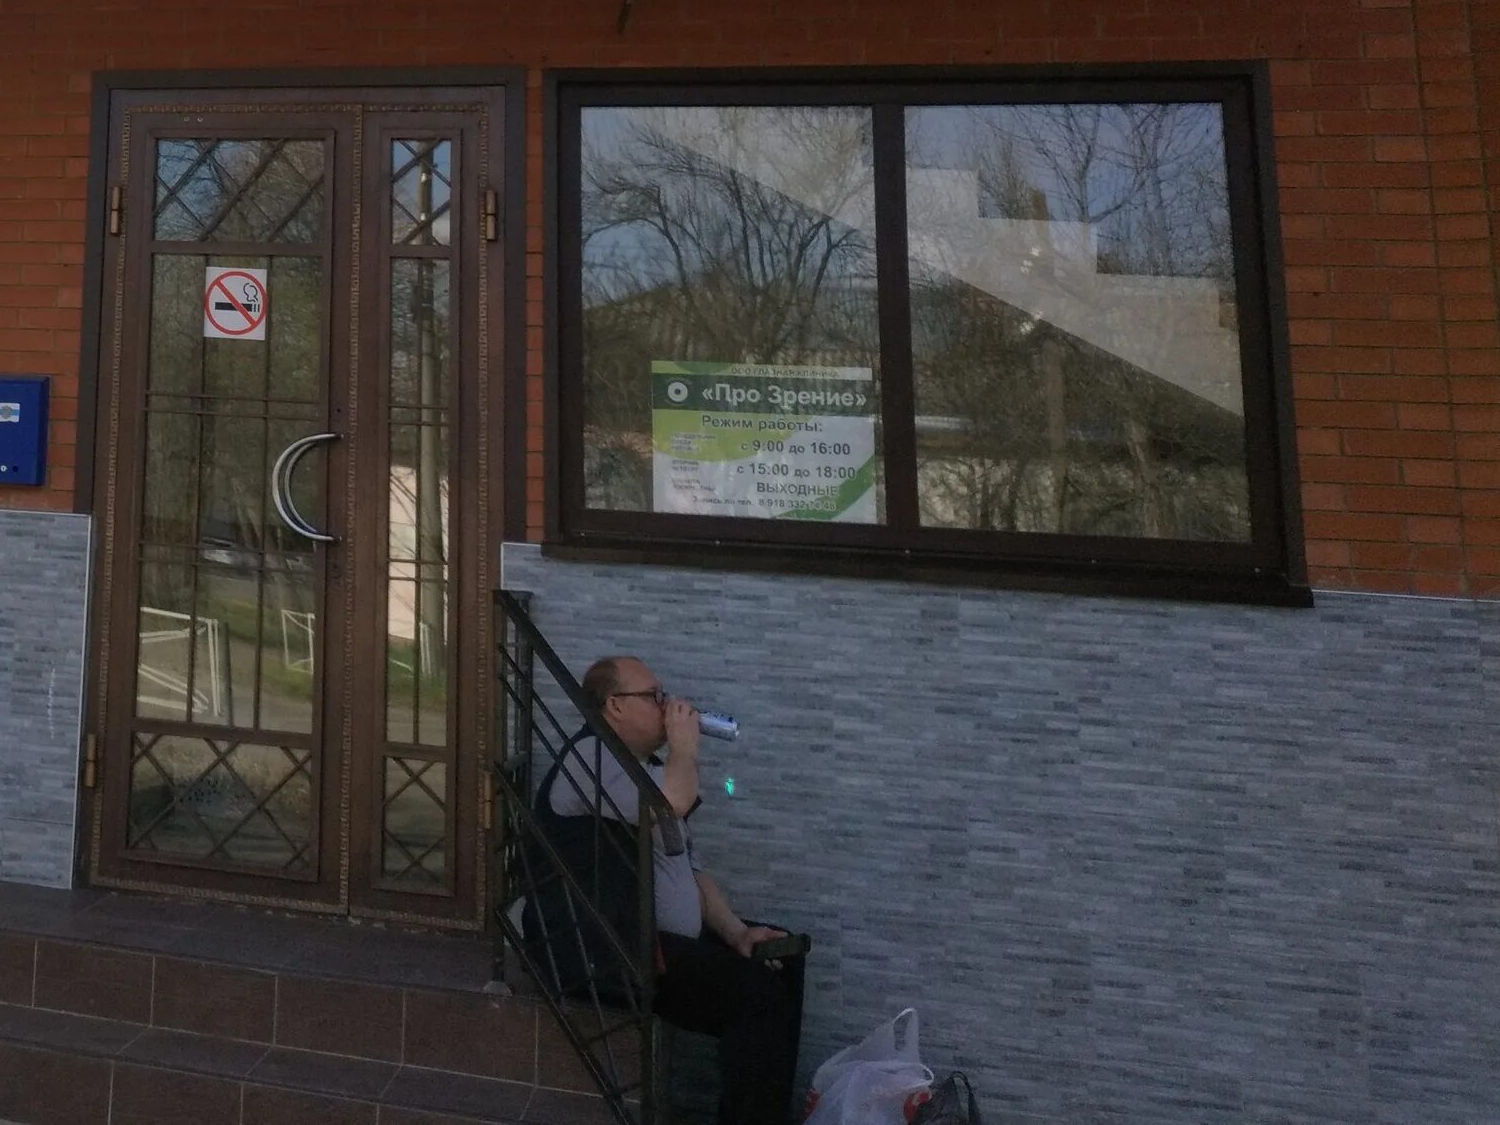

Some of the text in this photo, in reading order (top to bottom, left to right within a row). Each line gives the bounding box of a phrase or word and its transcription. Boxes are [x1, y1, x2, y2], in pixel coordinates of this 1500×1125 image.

[702, 383, 867, 408] «Про Зрение»
[702, 415, 823, 432] Режим работы:
[753, 440, 784, 453] 9:00
[789, 444, 805, 454] до
[810, 442, 850, 455] 16:00
[749, 463, 789, 476] 15:00
[795, 467, 810, 477] до
[816, 466, 855, 479] 18:00
